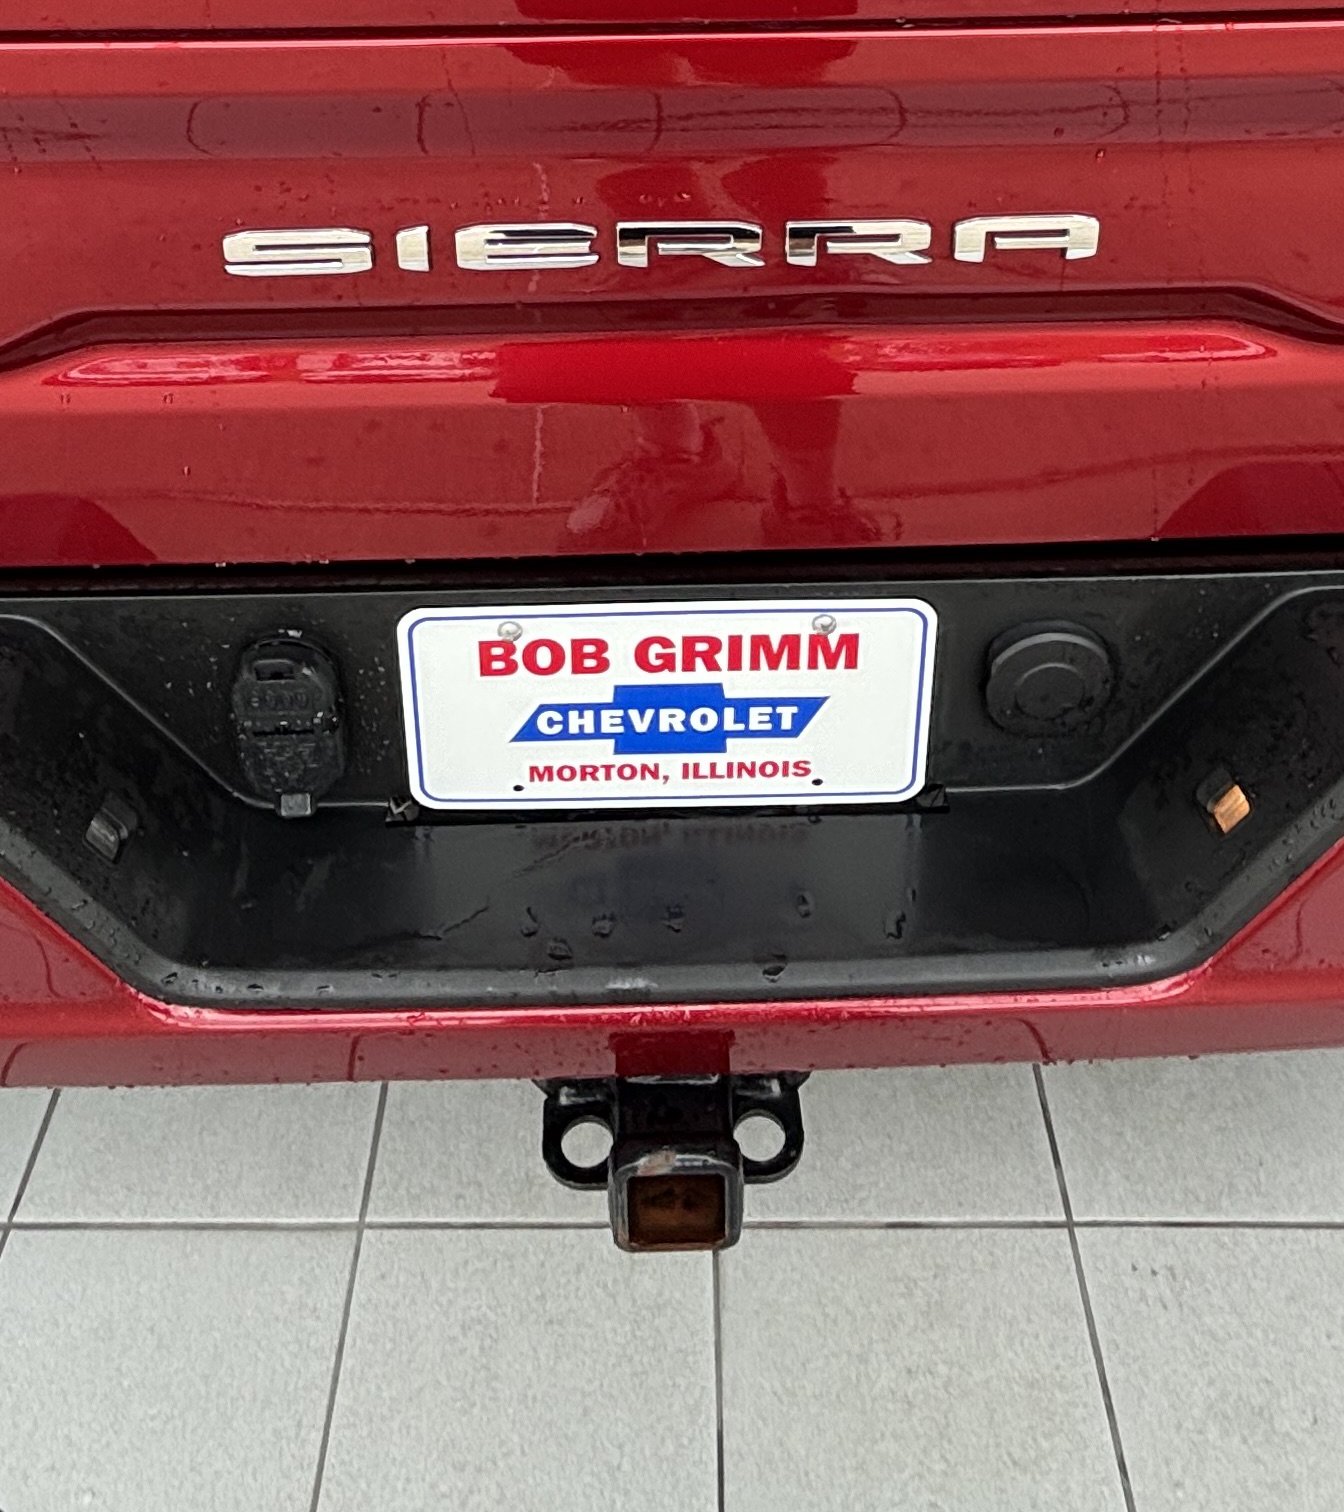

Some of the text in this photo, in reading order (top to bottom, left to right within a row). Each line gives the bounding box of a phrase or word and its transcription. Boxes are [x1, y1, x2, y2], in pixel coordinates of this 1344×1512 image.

[222, 213, 1100, 276] SIERRA
[478, 633, 860, 678] BOB GRIMM
[536, 705, 799, 736] CHEVROLET
[529, 759, 813, 785] MORTON, ILLINOIS
